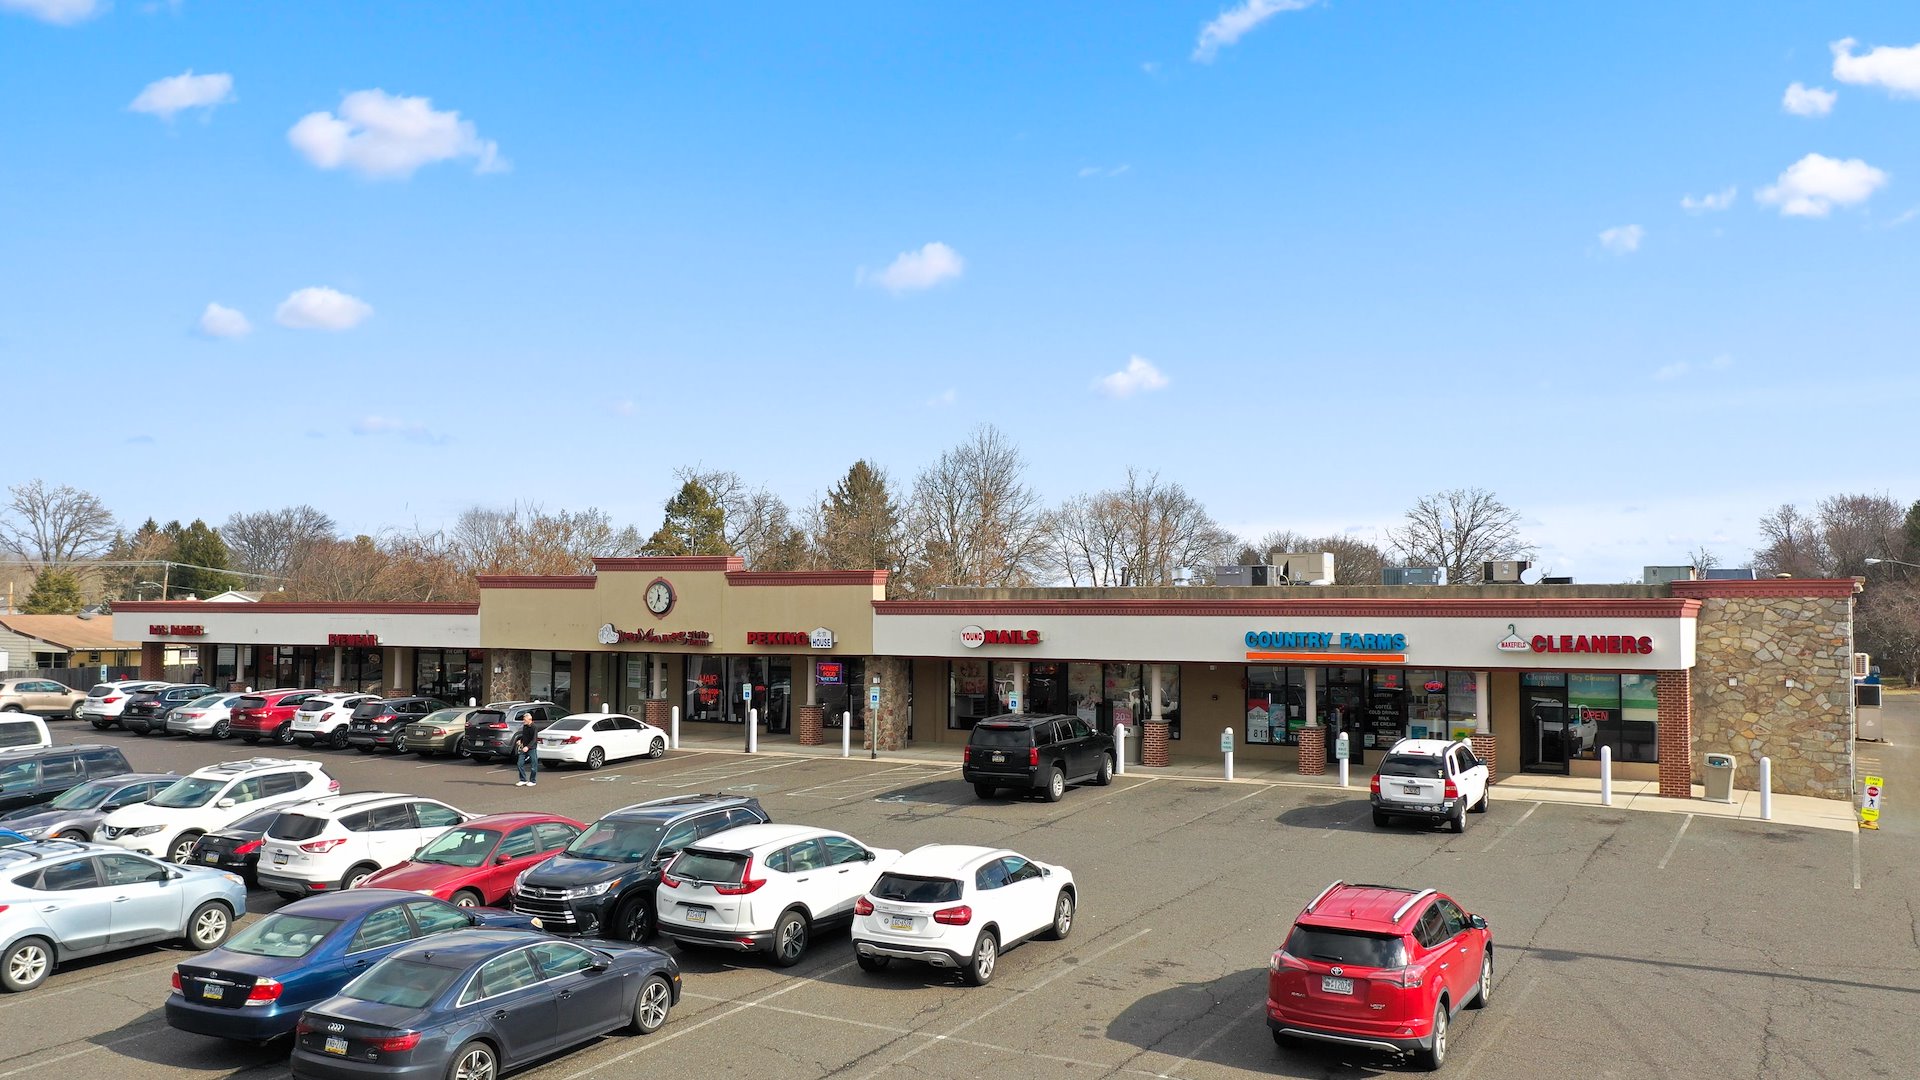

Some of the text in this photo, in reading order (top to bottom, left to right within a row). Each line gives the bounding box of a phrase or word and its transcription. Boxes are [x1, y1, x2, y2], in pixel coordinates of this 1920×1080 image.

[747, 631, 831, 647] PEKING HOUSE
[962, 630, 1039, 645] YOUNG NAILS
[1245, 631, 1407, 651] COUNTRY FARMS
[1501, 634, 1653, 655] WAKEFIELD CLEANERS
[1525, 673, 1560, 681] Cleaners
[1571, 674, 1583, 682] Dry
[1424, 682, 1443, 690] OPEN
[1582, 710, 1609, 721] OPEN
